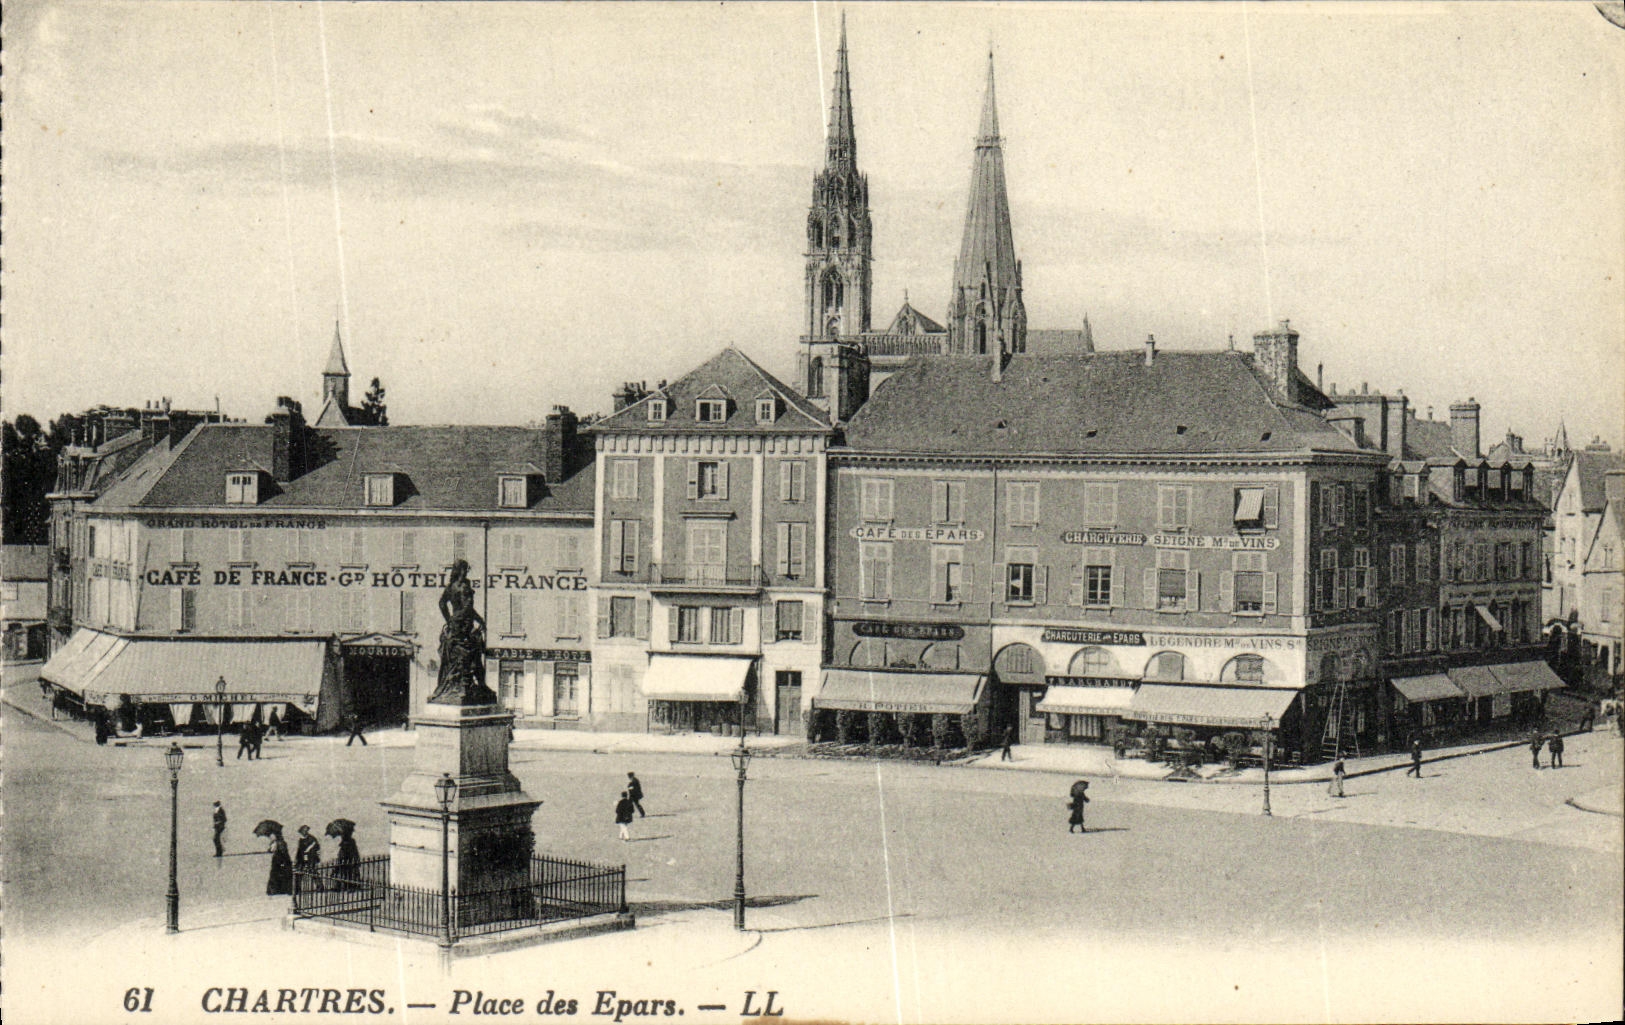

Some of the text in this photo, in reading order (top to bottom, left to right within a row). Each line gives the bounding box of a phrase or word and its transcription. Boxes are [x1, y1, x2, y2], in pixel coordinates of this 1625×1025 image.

[146, 519, 194, 529] GRAND
[265, 520, 326, 530] FRANCE
[925, 529, 978, 540] EPARS
[1065, 532, 1144, 545] CHARCUTERIE
[1241, 537, 1276, 549] VINS
[213, 571, 241, 586] DE
[251, 570, 328, 587] FRANCE
[487, 573, 589, 591] FRANCE
[1045, 630, 1102, 643] CHARCUTERIE
[1113, 633, 1140, 645] EPARS
[1150, 635, 1222, 648] LEGENDRE
[494, 648, 534, 659] TABLE
